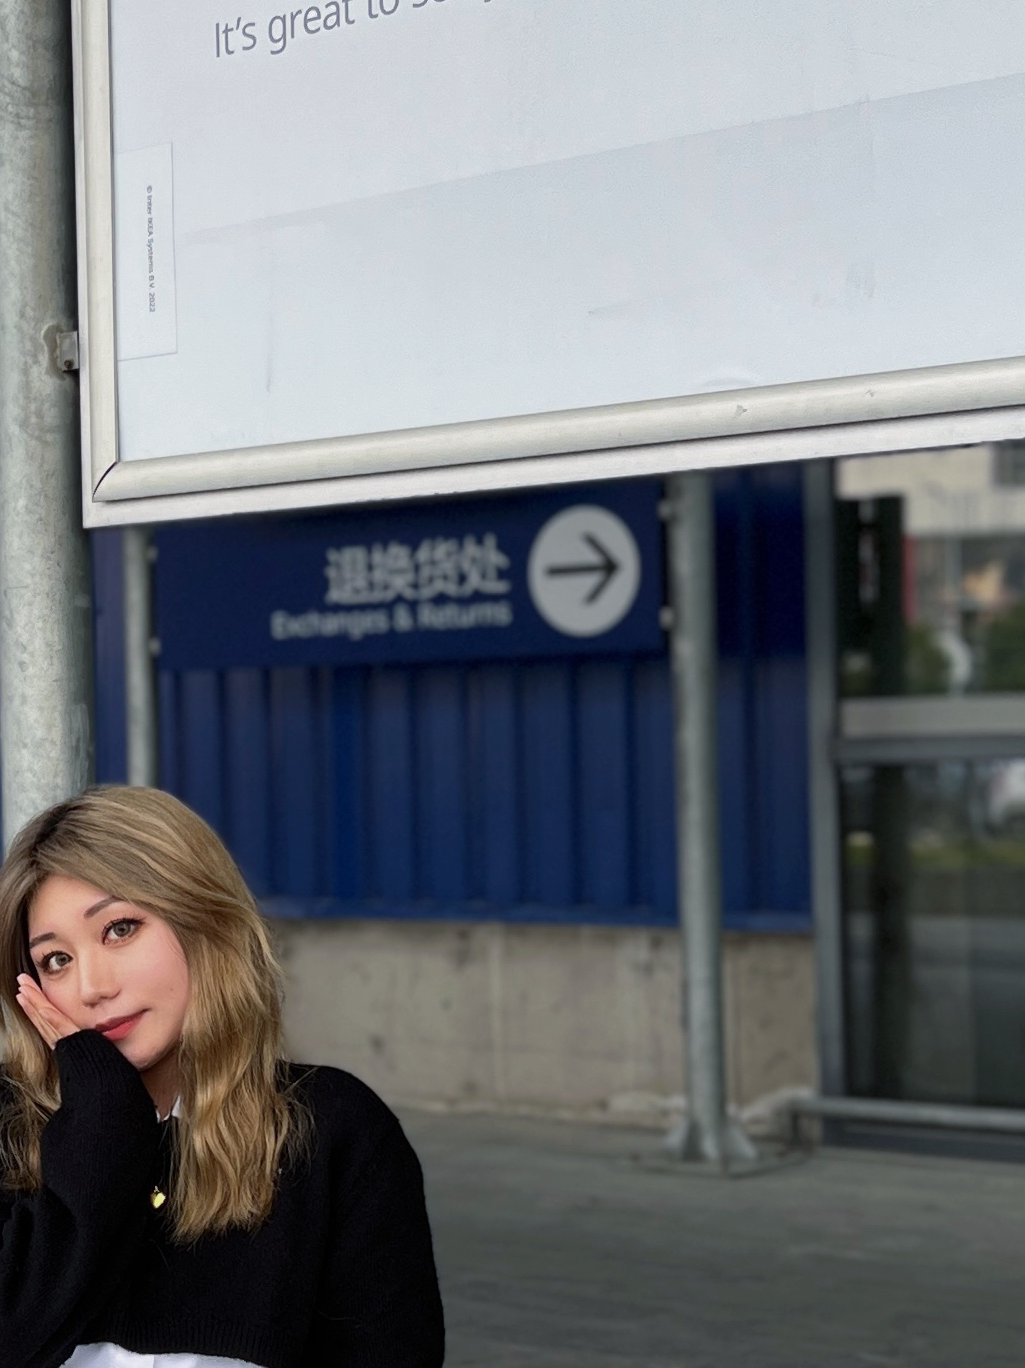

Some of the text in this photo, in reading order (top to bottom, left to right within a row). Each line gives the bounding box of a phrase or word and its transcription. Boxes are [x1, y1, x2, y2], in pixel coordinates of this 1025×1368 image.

[215, 17, 257, 58] It's
[268, 0, 355, 55] great
[146, 238, 154, 273] Systems
[325, 533, 511, 604] 退换货处
[272, 609, 390, 641] Exchanges
[417, 599, 513, 631] Returns
